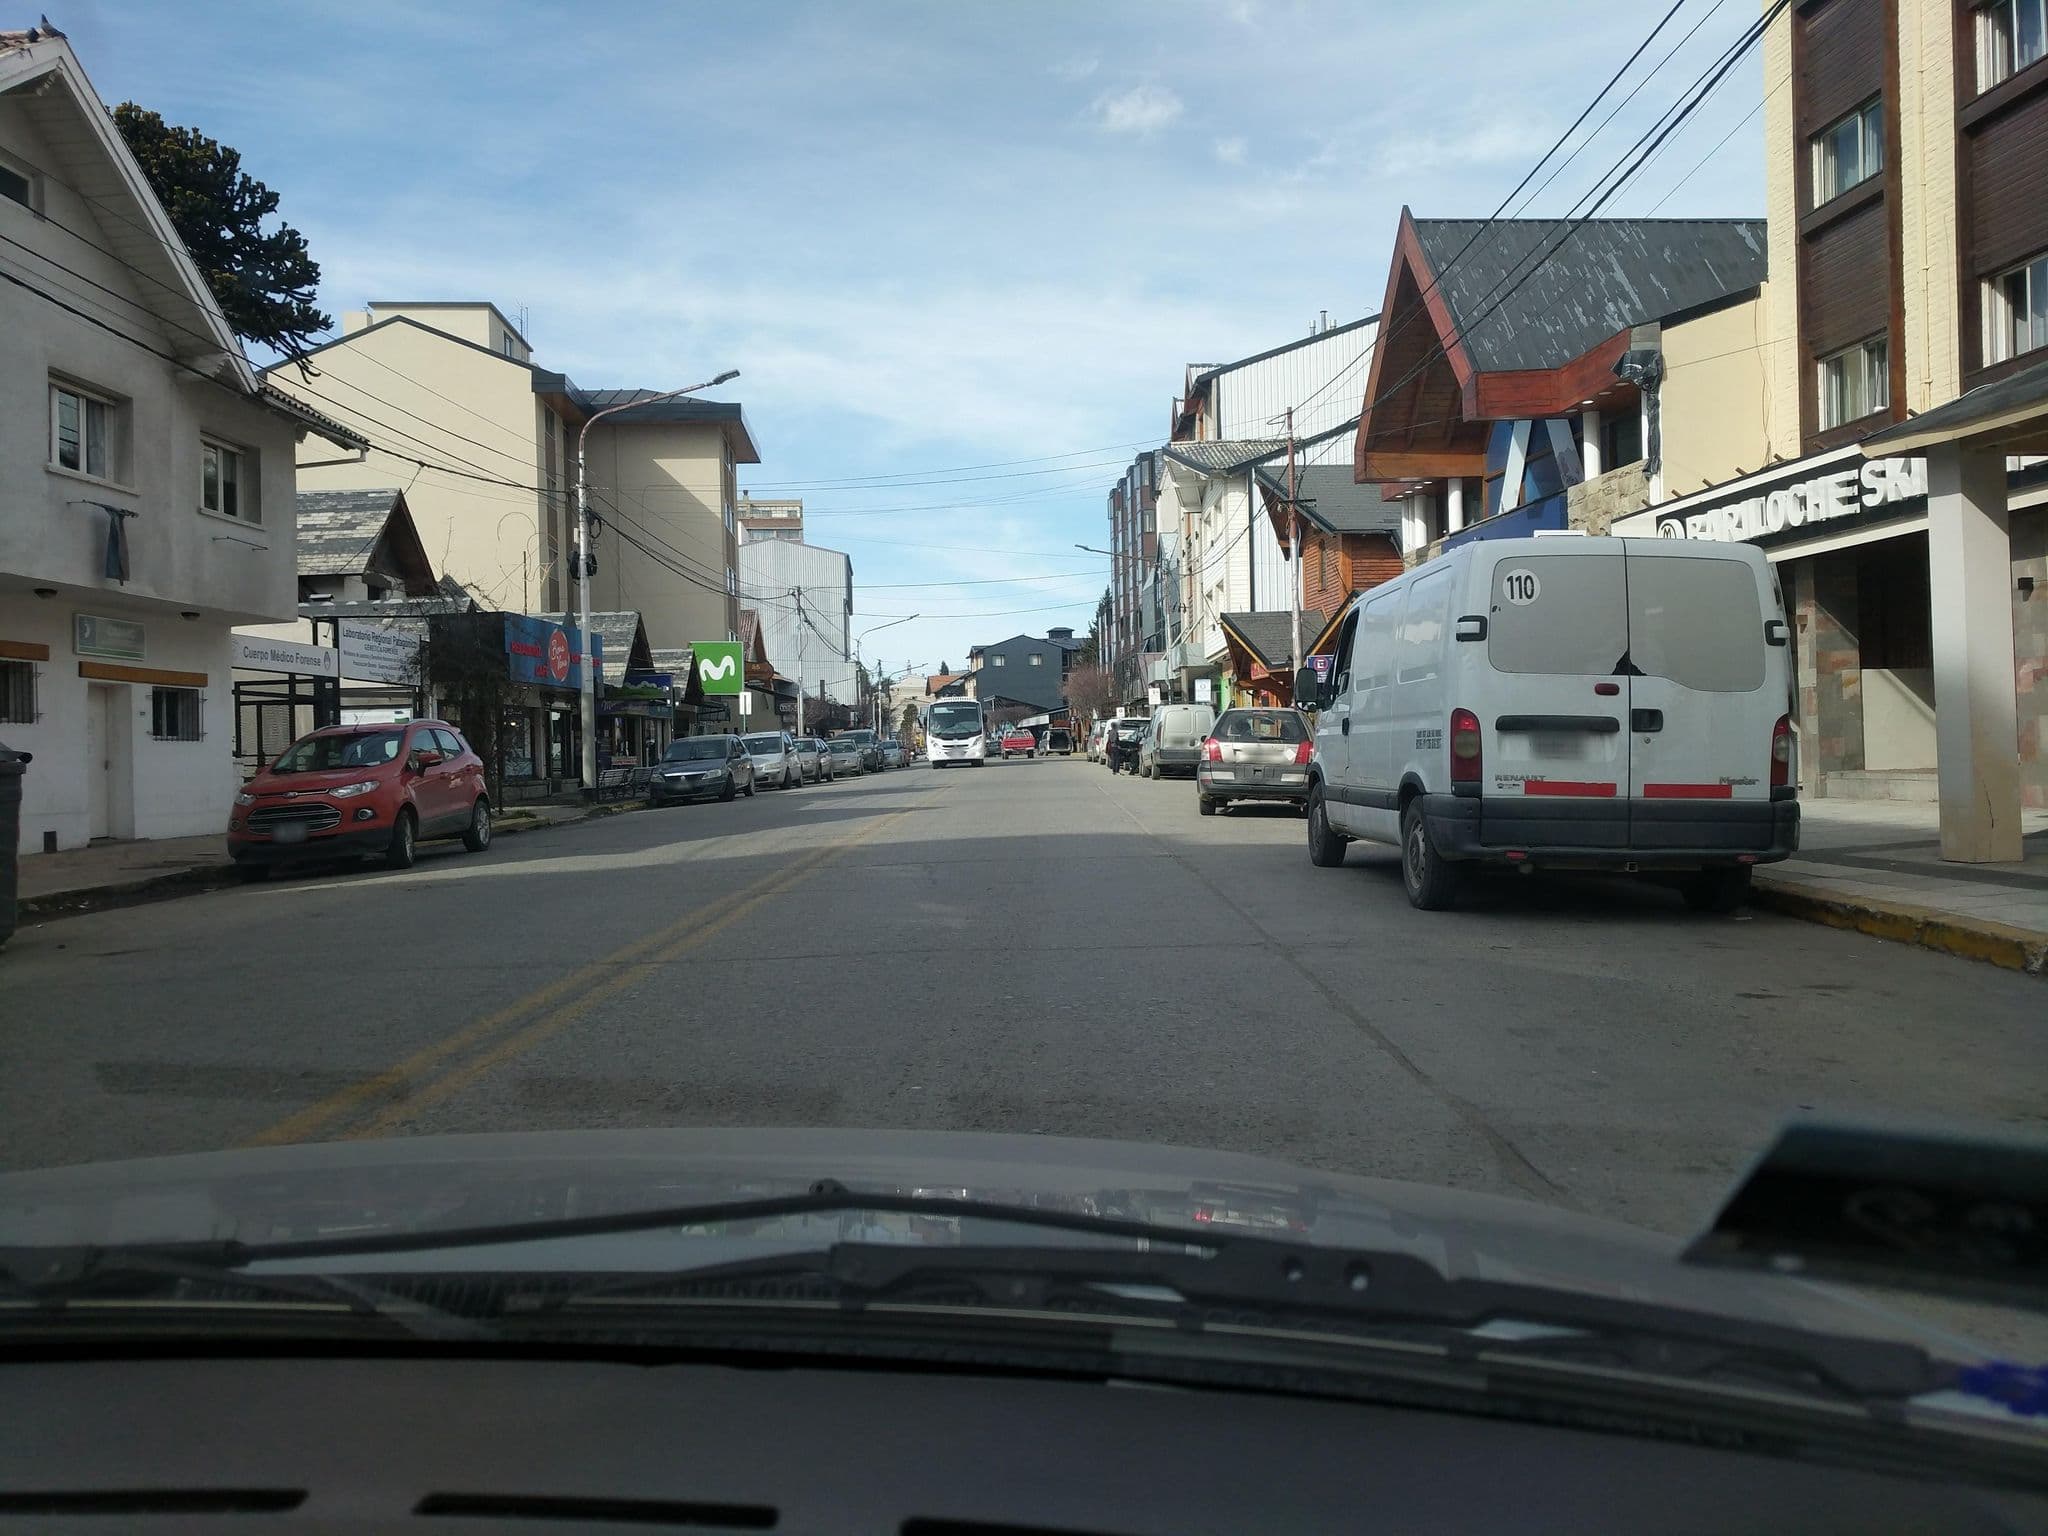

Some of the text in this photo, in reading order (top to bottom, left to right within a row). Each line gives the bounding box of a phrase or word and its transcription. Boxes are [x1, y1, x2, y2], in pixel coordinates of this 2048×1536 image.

[1686, 469, 1861, 543] BARILOCHE
[1506, 574, 1535, 600] 110
[243, 646, 269, 663] Cuerpo
[295, 652, 321, 667] Forense
[1495, 774, 1546, 782] RENAULT
